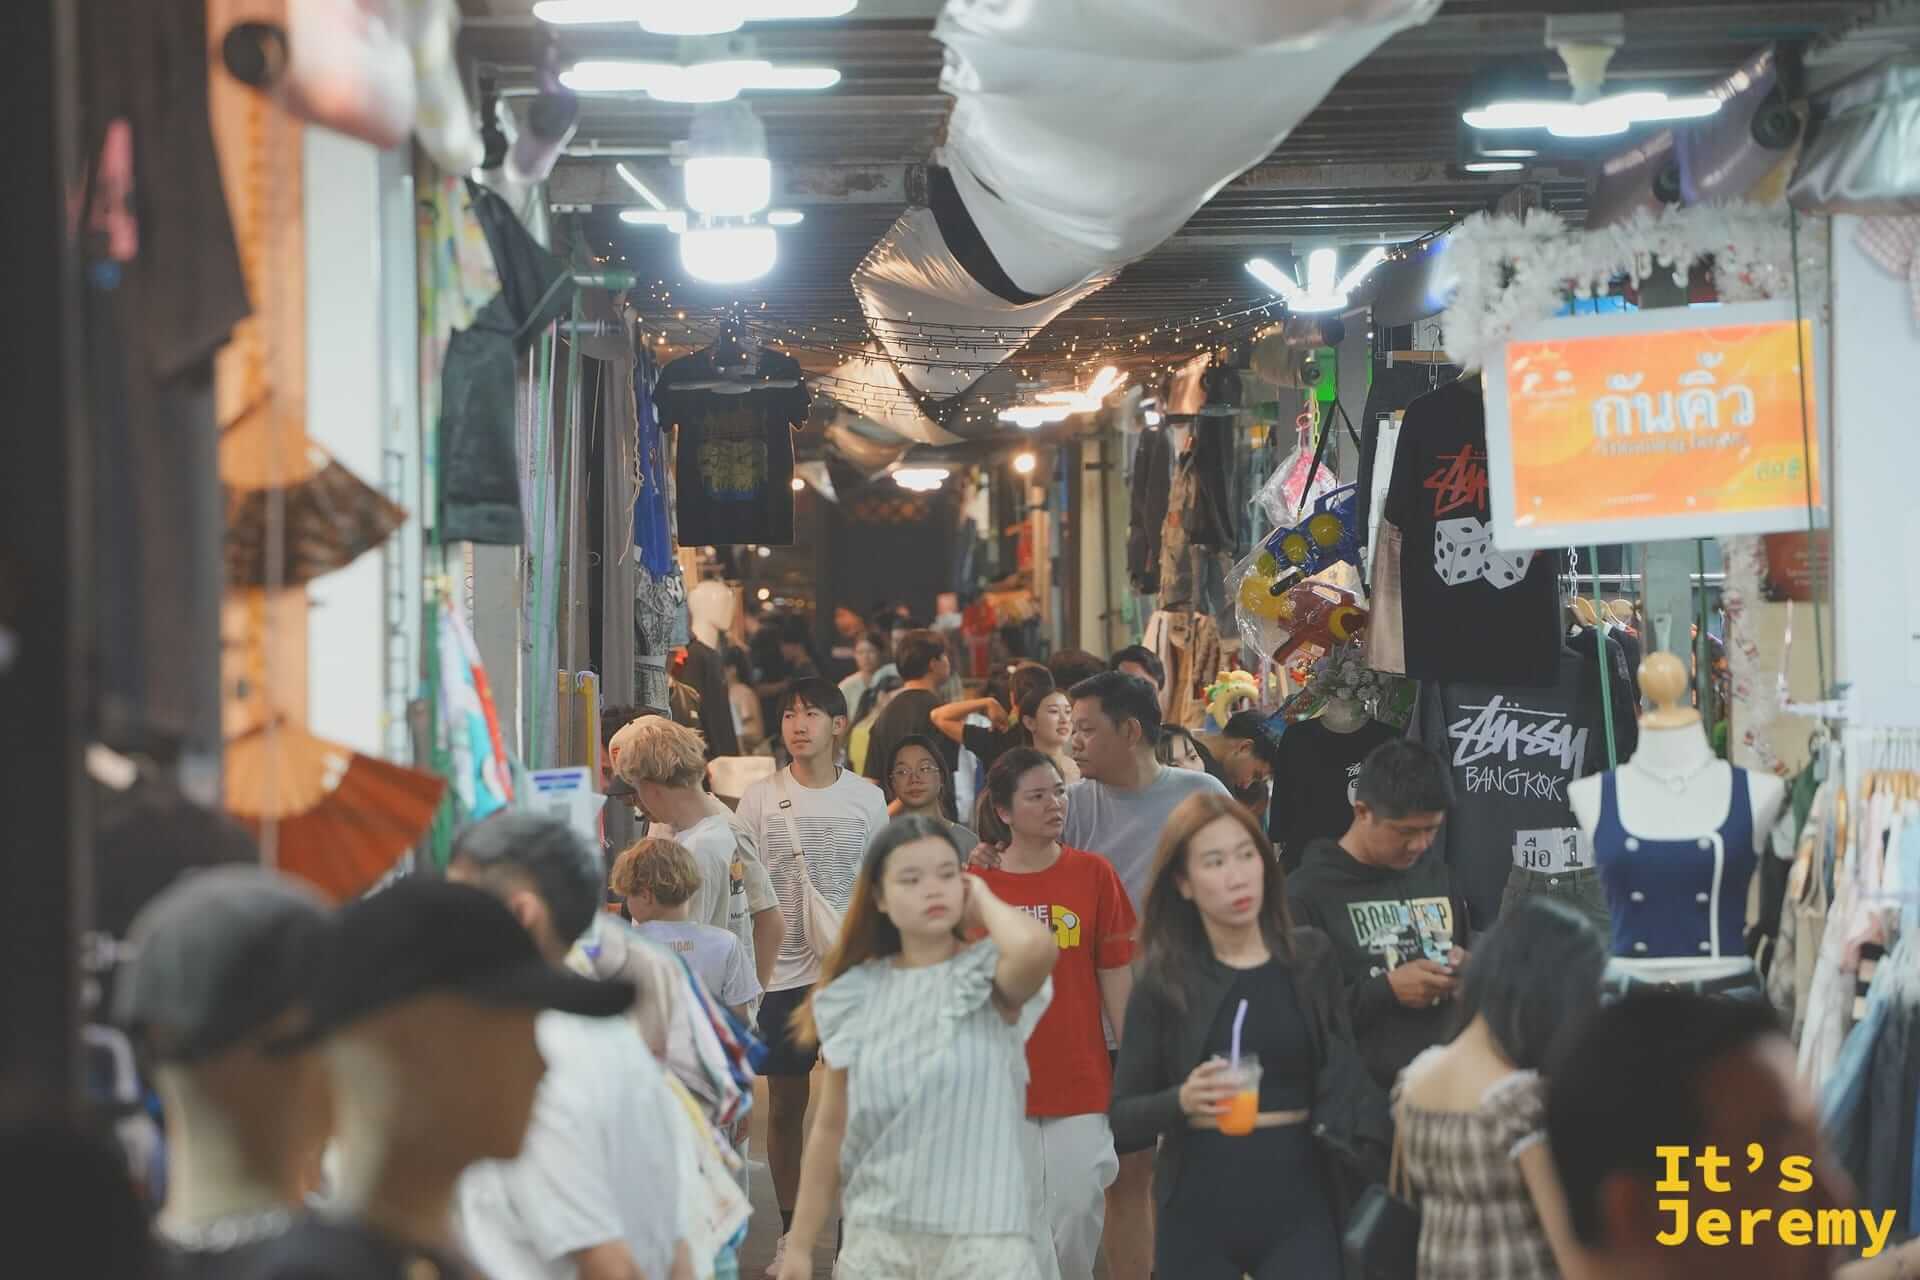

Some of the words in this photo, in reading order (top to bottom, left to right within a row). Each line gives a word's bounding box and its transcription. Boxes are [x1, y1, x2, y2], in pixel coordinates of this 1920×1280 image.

[1592, 351, 1756, 437] กันคิ้ว
[1521, 836, 1551, 868] มือ
[1562, 835, 1584, 868] 1
